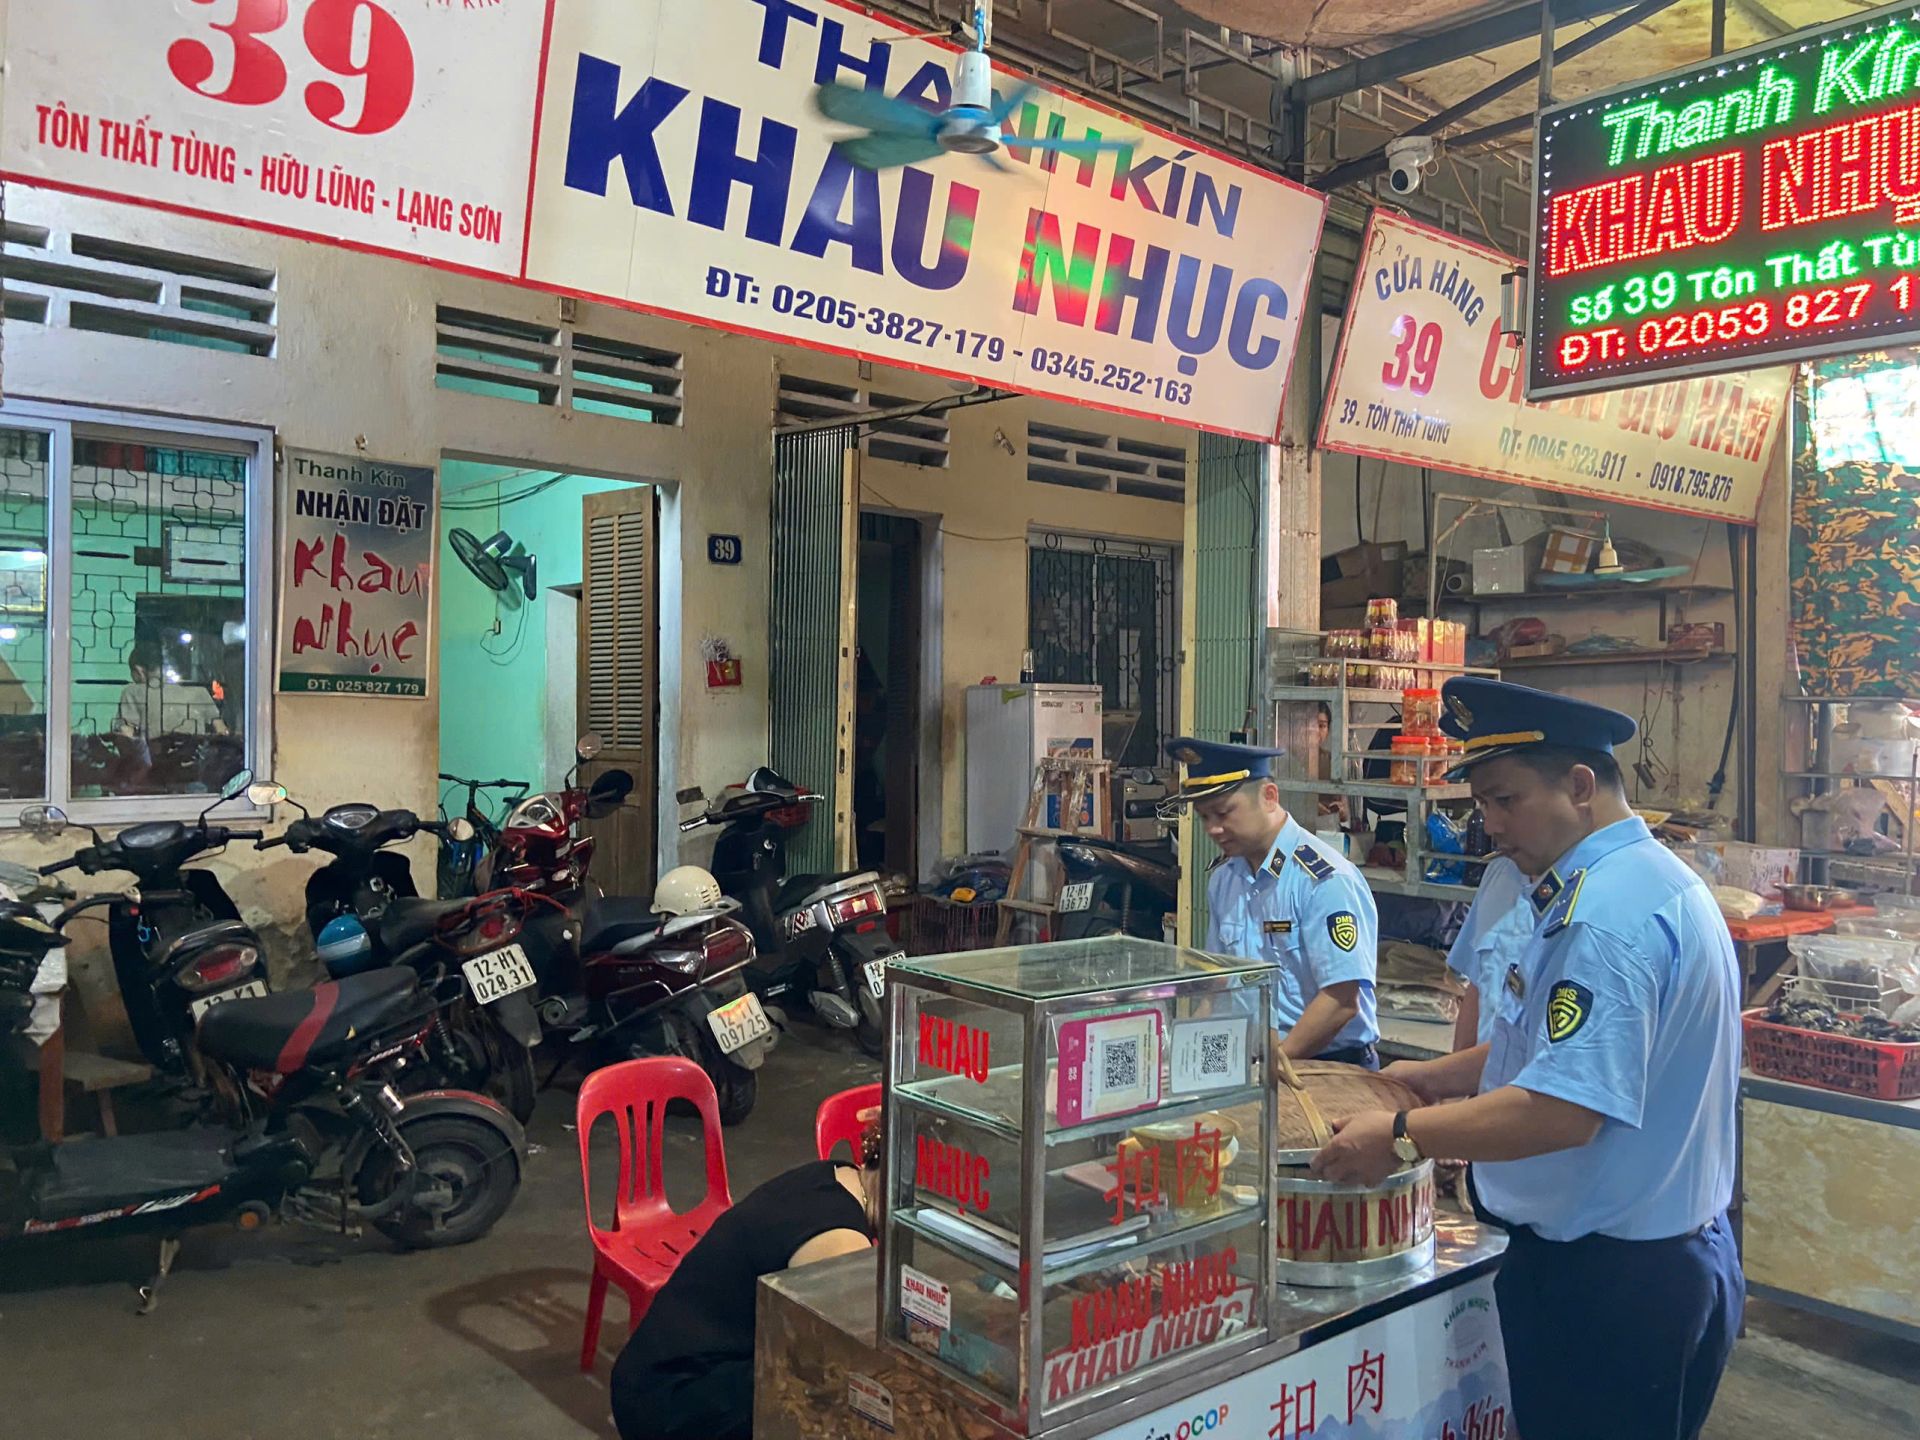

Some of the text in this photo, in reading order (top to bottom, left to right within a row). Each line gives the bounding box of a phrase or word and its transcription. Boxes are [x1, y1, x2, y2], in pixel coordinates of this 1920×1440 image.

[167, 0, 414, 135] 39
[1602, 66, 1796, 167] Thanh
[36, 101, 90, 153] TÔN
[98, 115, 163, 168] THẤT
[170, 130, 236, 184] TÙNG
[260, 152, 310, 199] HỮU
[315, 165, 376, 215] LŨNG
[396, 187, 454, 233] LẠNG
[458, 203, 503, 244] SƠN
[1108, 146, 1242, 240] KÍN
[563, 53, 978, 291] KHAU
[1012, 207, 1289, 376] NHỤC
[1548, 152, 1744, 276] KHAU
[706, 265, 760, 305] ĐT:
[1375, 244, 1485, 328] CỬA HÀNG
[1569, 231, 1920, 326] Số 39 Tôn Thất Tù
[1381, 314, 1444, 398] 39
[1560, 275, 1920, 367] ĐT: 02053 827 1
[294, 458, 363, 483] Thanh
[295, 488, 427, 533] NHẬN ĐẶT
[293, 531, 423, 600] Khau
[714, 538, 736, 561] 39
[292, 598, 420, 675] Nhục
[306, 678, 332, 691] ĐT:
[473, 949, 517, 978] 12-H1
[476, 965, 530, 999] 028.31
[719, 1014, 767, 1050] 097.25
[918, 1012, 990, 1085] KHAU
[916, 1134, 990, 1216] NHỤC
[1071, 1275, 1152, 1355] KHAU
[1049, 1315, 1146, 1400] KHAU
